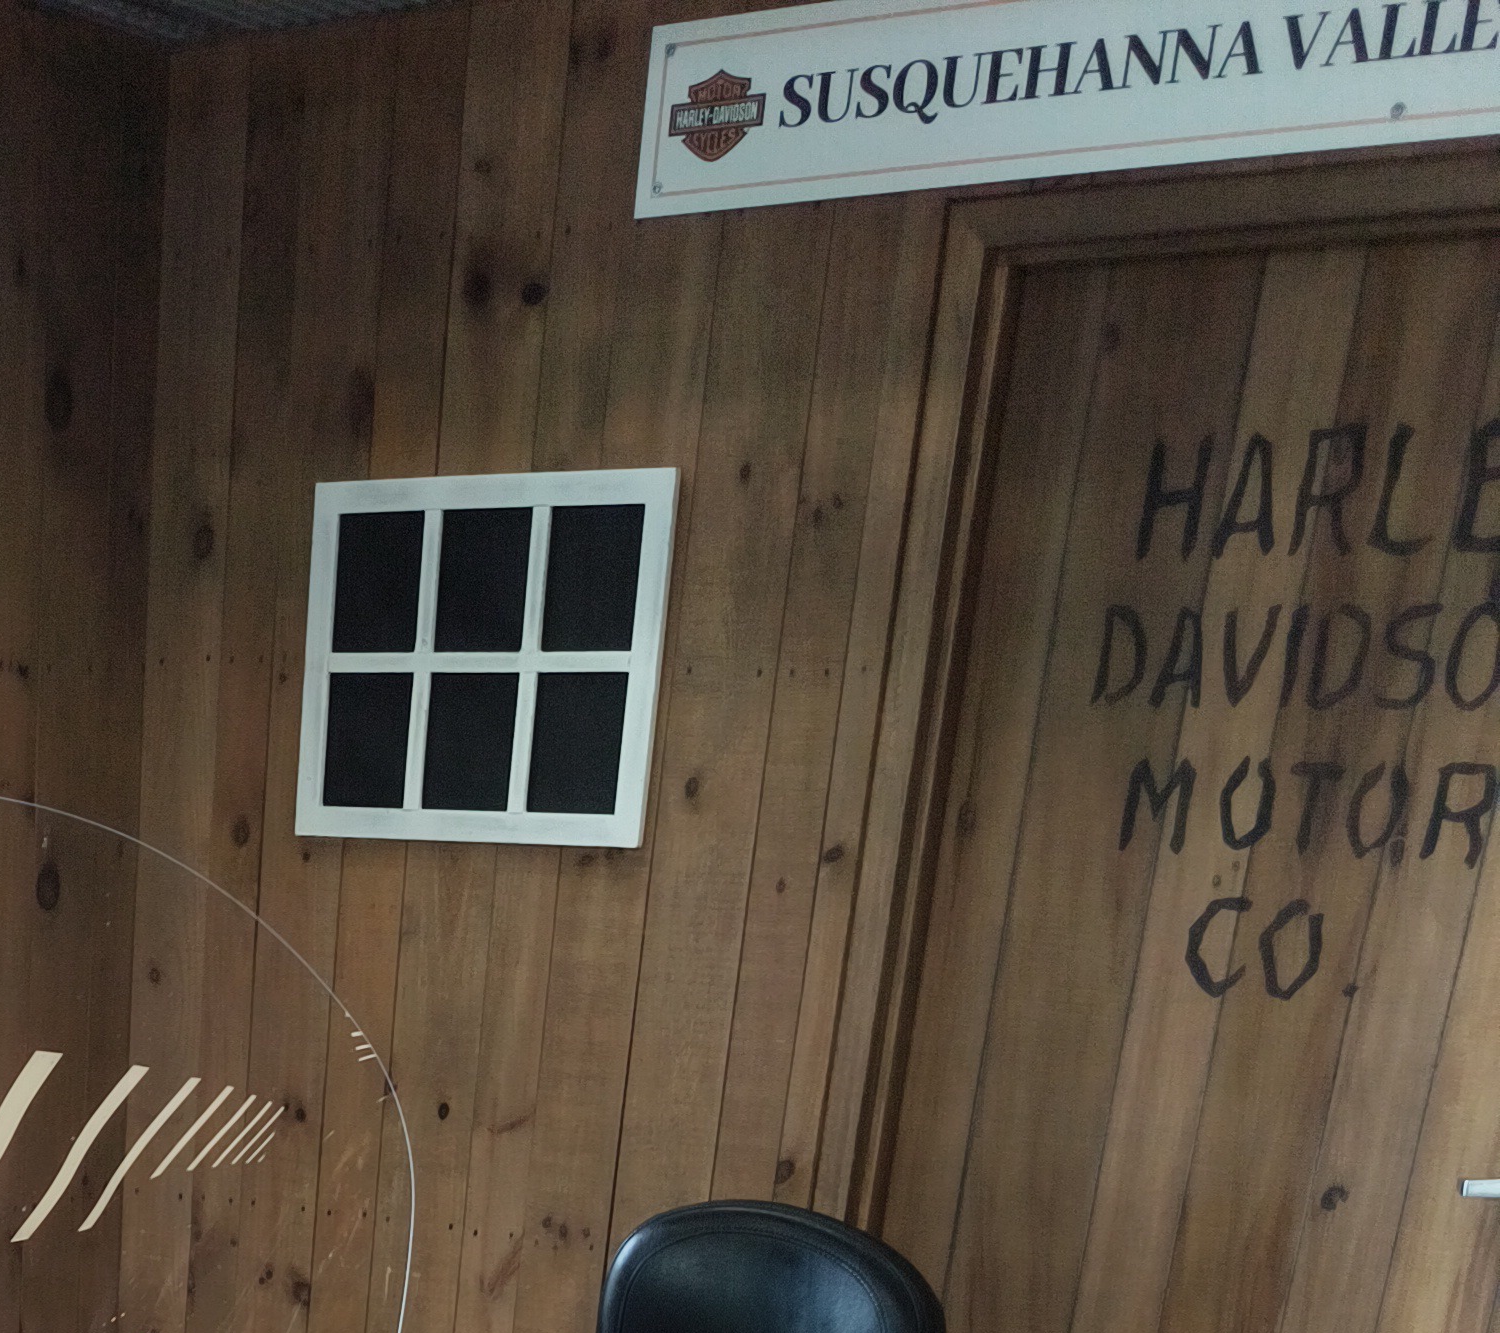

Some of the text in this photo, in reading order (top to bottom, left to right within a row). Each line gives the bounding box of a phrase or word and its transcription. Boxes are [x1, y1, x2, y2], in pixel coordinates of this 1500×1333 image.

[675, 100, 759, 130] HARLEY-DAVIDSON
[778, 0, 1500, 129] SUSQUEHANNA VALLE
[1136, 419, 1500, 561] HARLE
[1091, 601, 1500, 711] DAVIDSO
[1118, 755, 1498, 869] MOTOR
